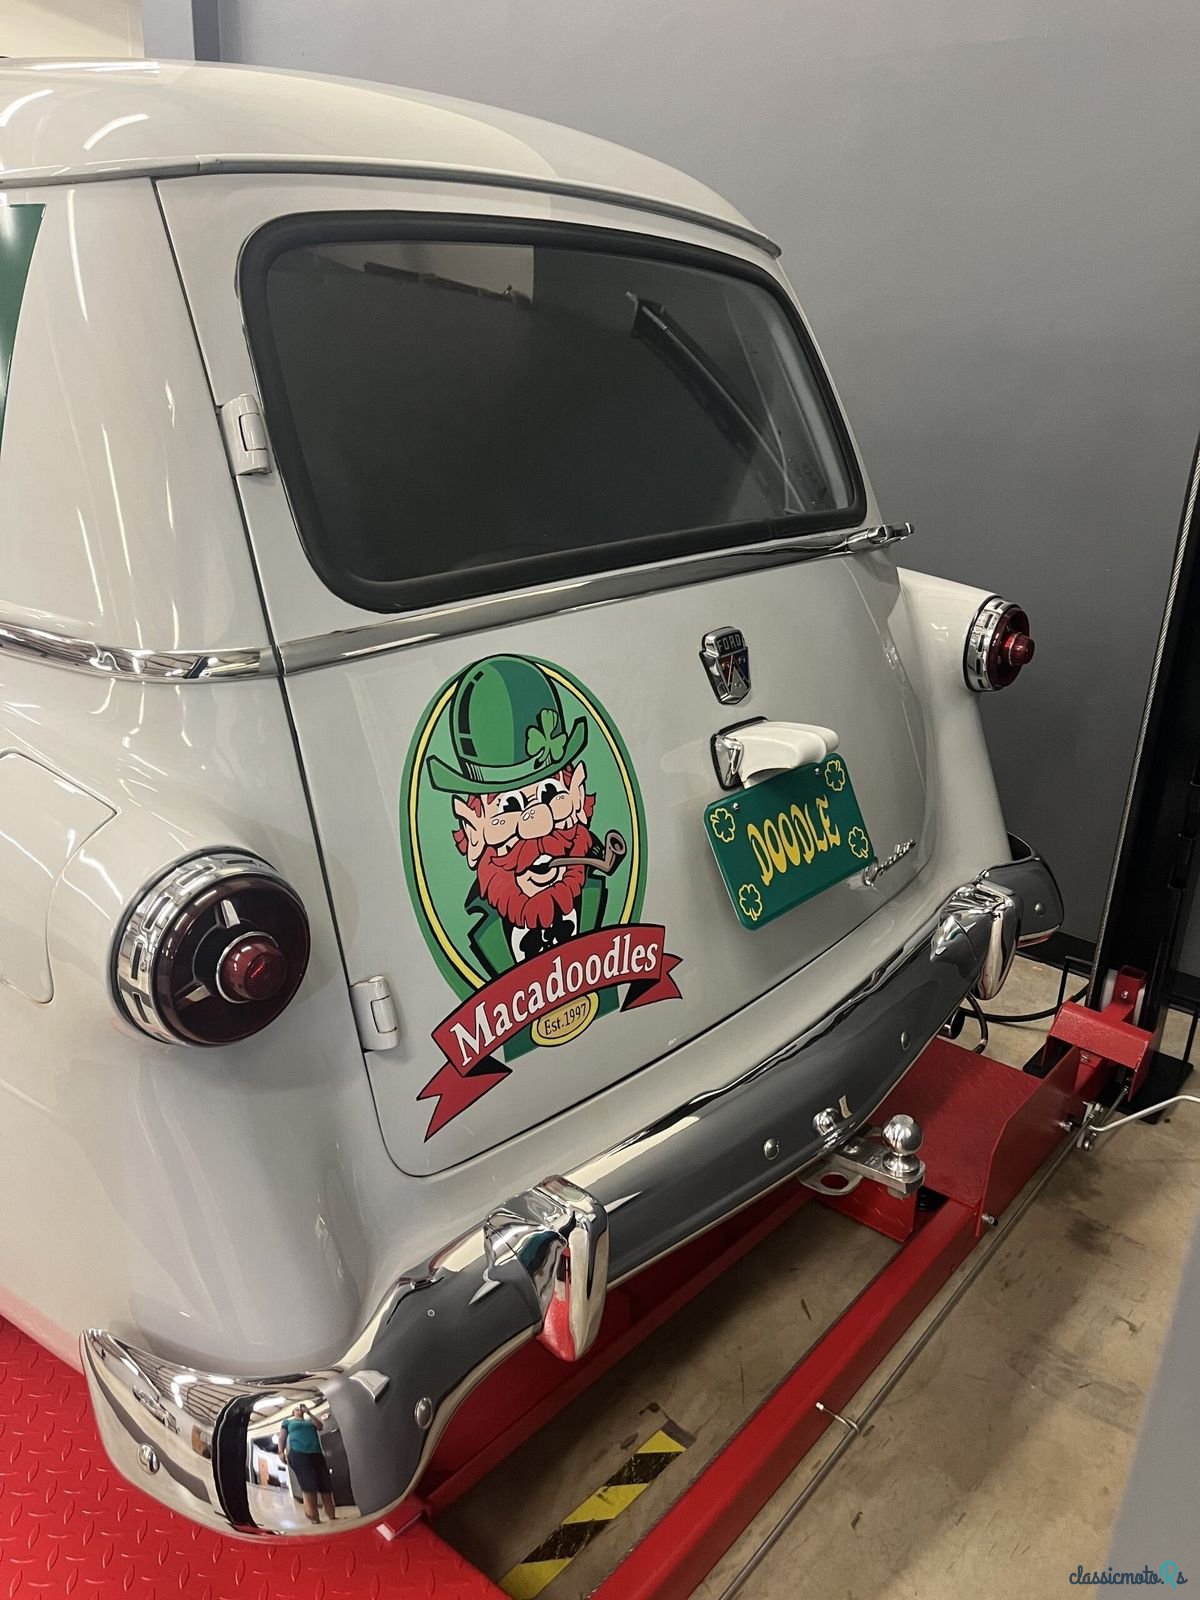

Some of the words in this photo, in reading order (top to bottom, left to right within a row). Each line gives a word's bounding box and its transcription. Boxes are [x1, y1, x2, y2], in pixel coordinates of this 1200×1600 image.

[717, 634, 742, 652] FORD
[747, 794, 841, 886] DOODLE
[450, 932, 659, 1066] Macadoodles
